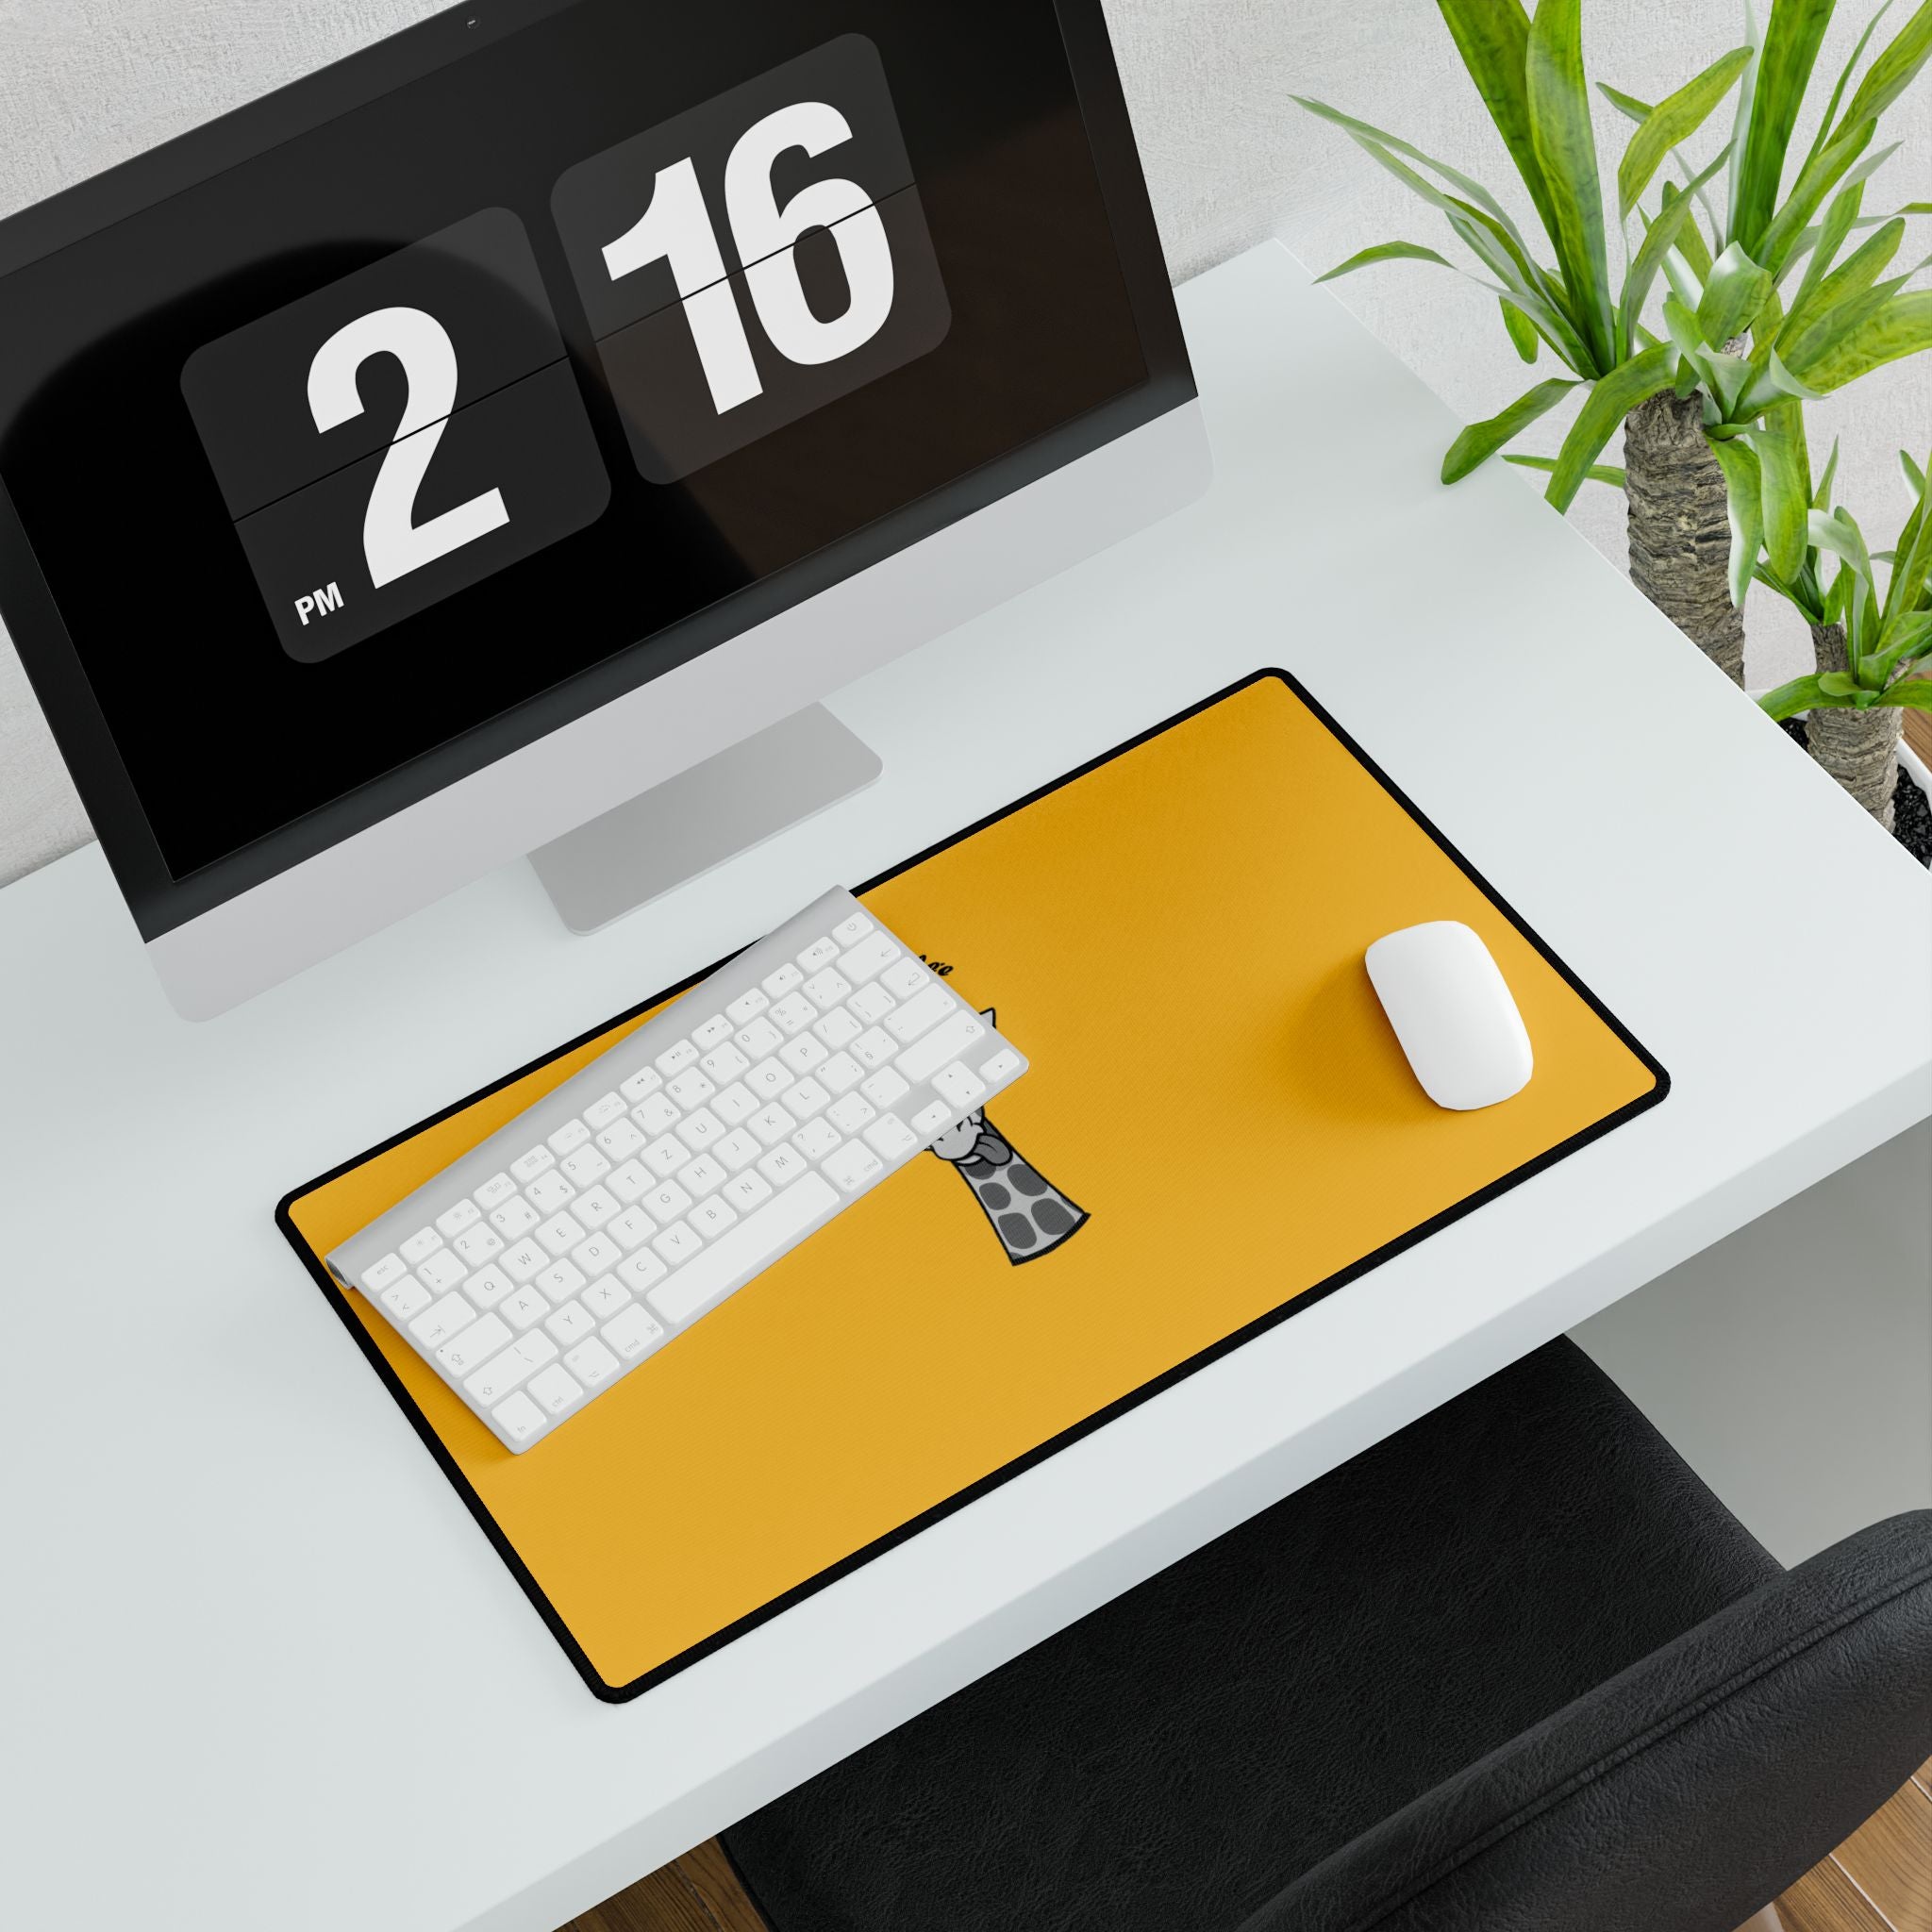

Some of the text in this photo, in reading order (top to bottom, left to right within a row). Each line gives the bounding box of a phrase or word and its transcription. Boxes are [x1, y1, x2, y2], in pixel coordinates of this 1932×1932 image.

[306, 101, 894, 590] 2 16
[294, 581, 344, 626] PM
[799, 1047, 808, 1058] P
[706, 1058, 715, 1069] 9
[672, 1084, 682, 1093] 8
[799, 1091, 810, 1101] L
[637, 1109, 648, 1121] 7
[764, 1115, 776, 1126] K
[694, 1122, 708, 1134] U
[603, 1136, 612, 1145] 6
[731, 1141, 741, 1152] J
[660, 1148, 673, 1160] Z
[566, 1160, 577, 1171] 5
[774, 1156, 790, 1169] M
[693, 1166, 708, 1178] H
[625, 1174, 637, 1185] T
[533, 1187, 542, 1196] 4
[740, 1181, 754, 1194] N
[659, 1192, 672, 1204] G
[591, 1201, 603, 1212] R
[495, 1213, 506, 1224] 3
[705, 1209, 717, 1221] B
[624, 1219, 634, 1230] F
[555, 1227, 567, 1239] E
[459, 1240, 471, 1250] 2
[670, 1235, 680, 1245] V
[588, 1246, 600, 1257] D
[517, 1252, 532, 1266] W
[636, 1260, 647, 1273] C
[553, 1273, 564, 1284] S
[483, 1281, 496, 1291] Q
[598, 1288, 612, 1300] X
[518, 1300, 529, 1311] A
[562, 1314, 574, 1325] Y
